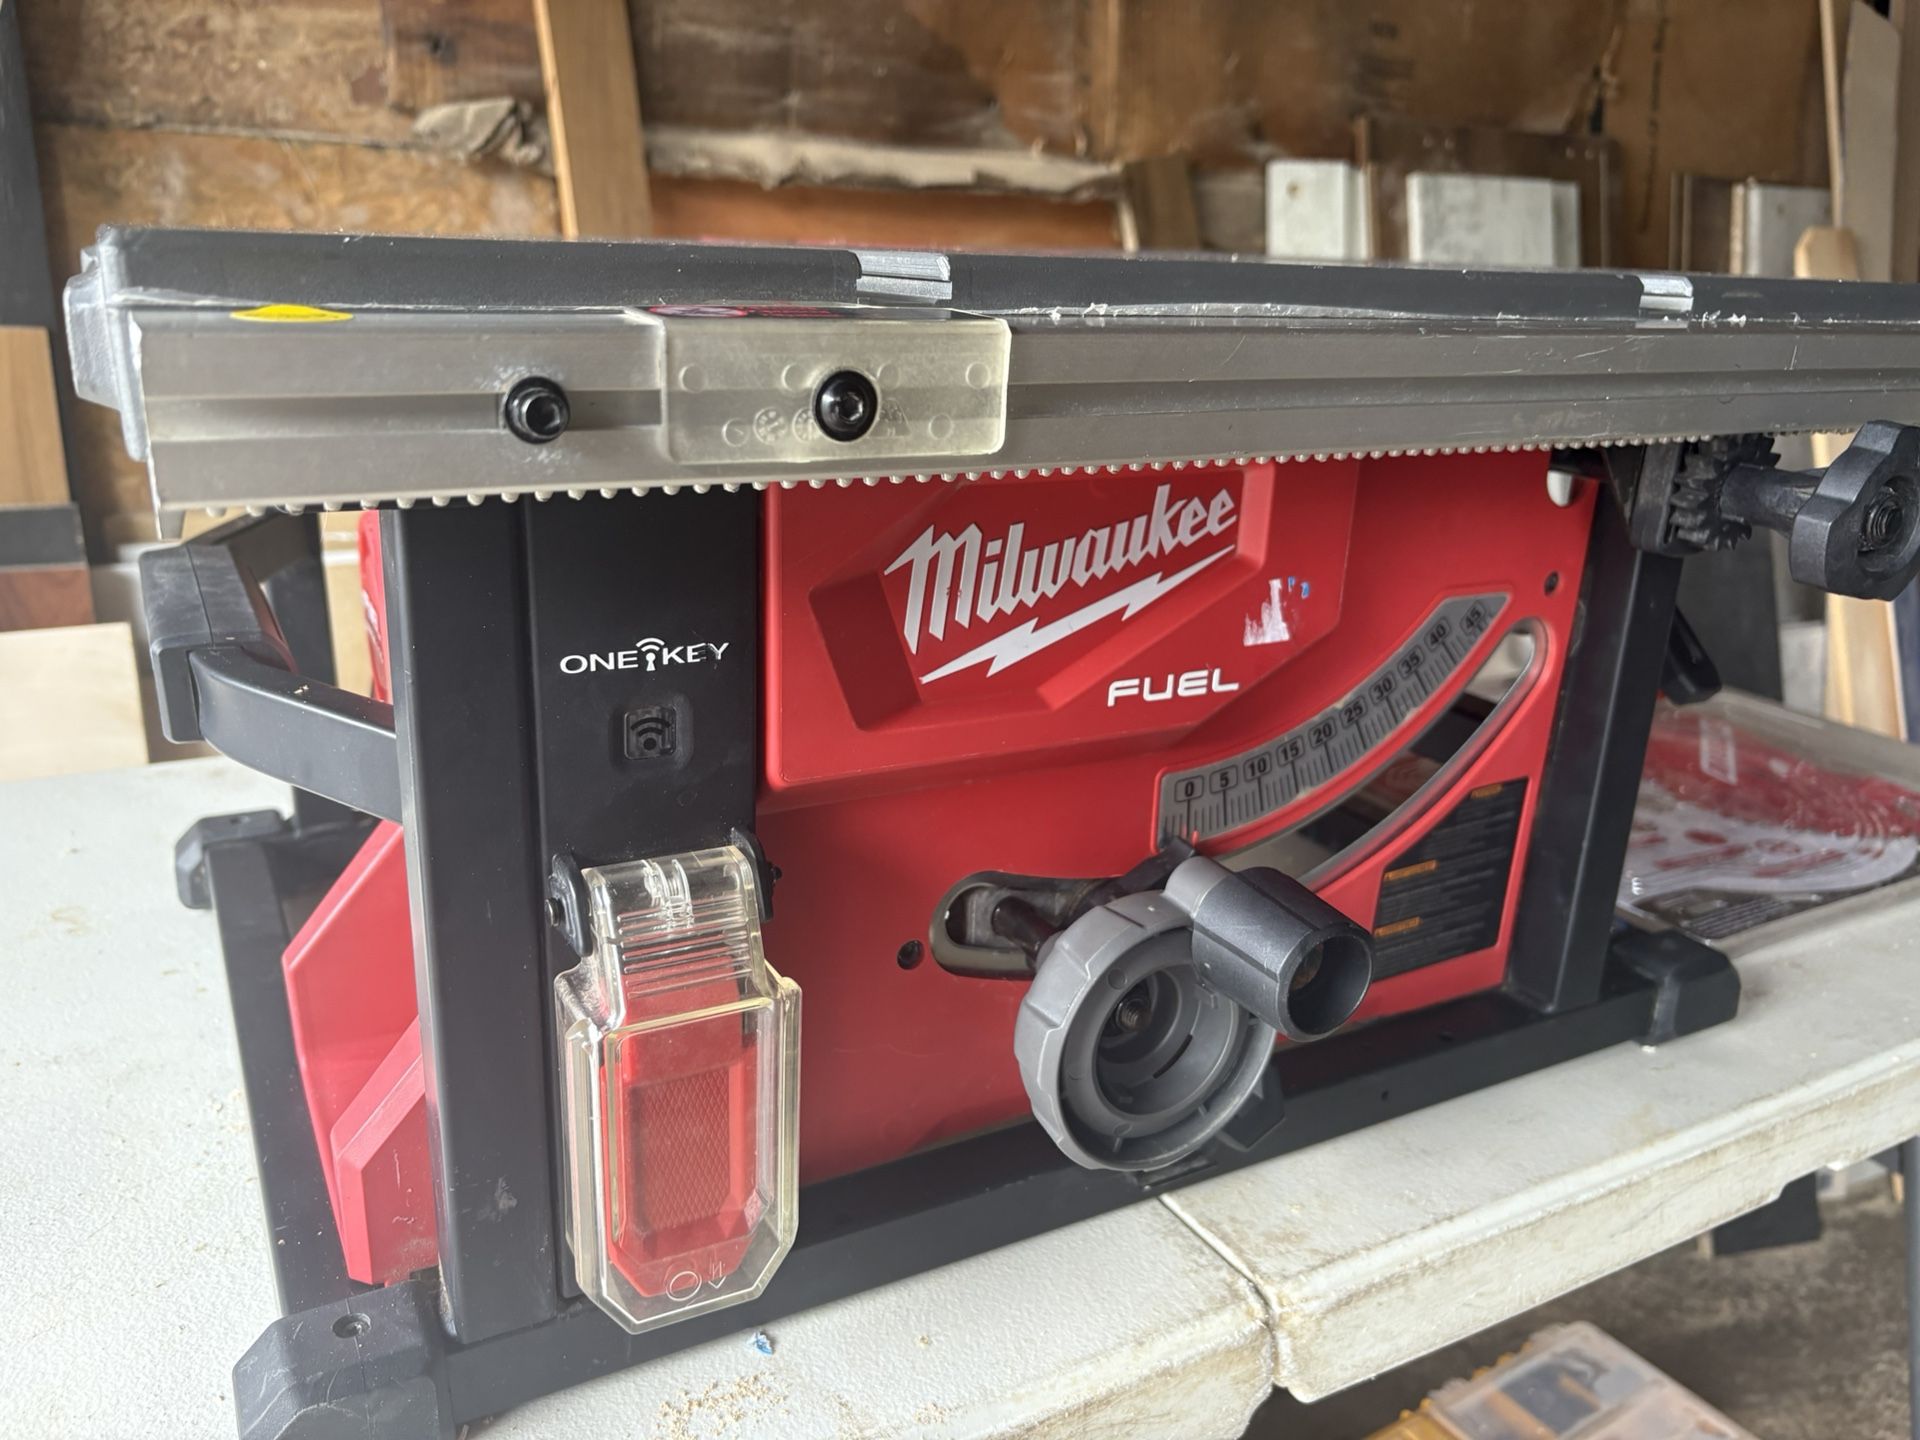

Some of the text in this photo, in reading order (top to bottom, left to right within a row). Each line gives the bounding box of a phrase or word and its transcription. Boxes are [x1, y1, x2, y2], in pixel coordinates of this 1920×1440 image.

[884, 483, 1237, 656] Milwaukee
[560, 642, 729, 674] ONE KEY
[1107, 667, 1239, 707] FUEL
[1184, 608, 1482, 798] 0 5 10 15 20 25 30 35 40 45
